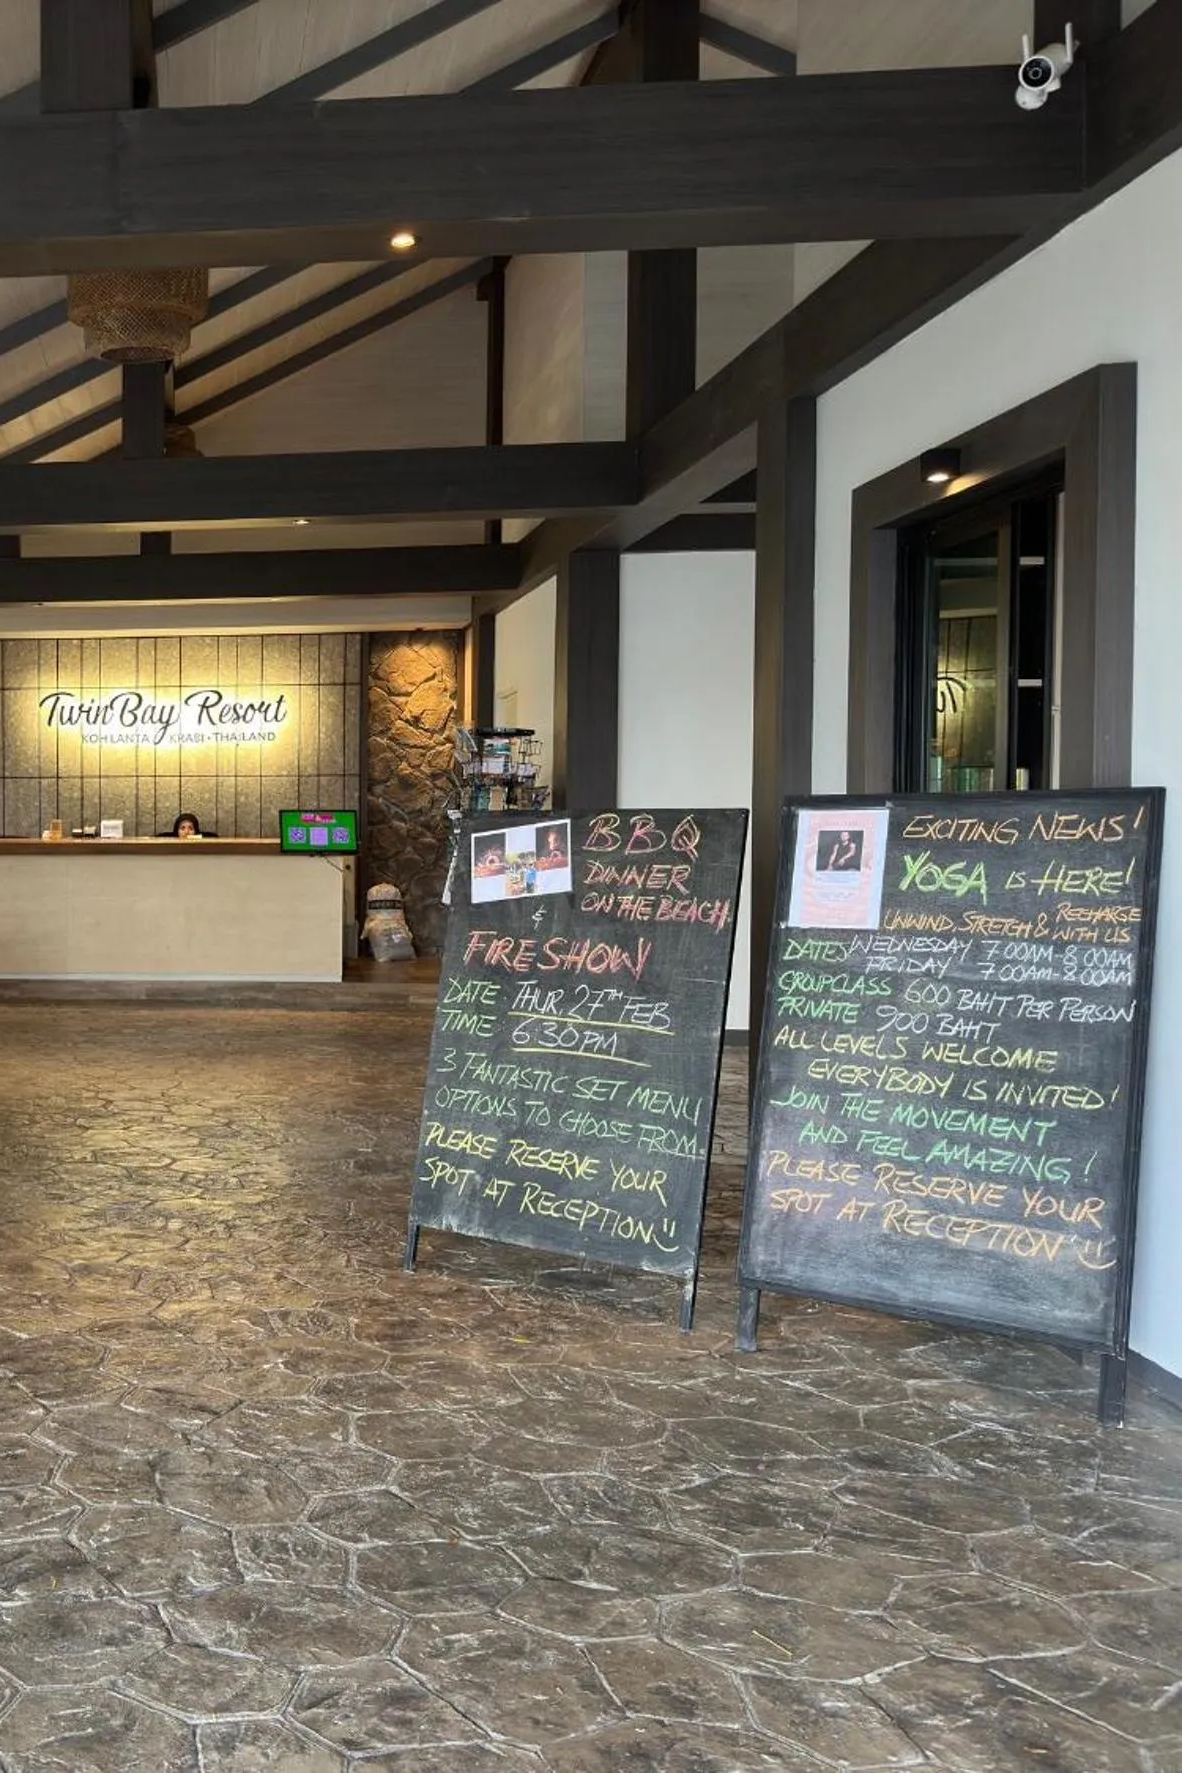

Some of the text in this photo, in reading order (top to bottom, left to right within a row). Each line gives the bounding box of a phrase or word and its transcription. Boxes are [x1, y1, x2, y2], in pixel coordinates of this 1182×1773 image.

[39, 690, 287, 745] Twin Bay Resort
[81, 731, 276, 744] KOH LANTA KRABI THAILAND
[582, 813, 701, 861] BBQ
[902, 814, 1019, 845] EXCITING
[583, 860, 691, 894] DINNER
[898, 849, 987, 905] YOGA
[581, 891, 615, 914] ON
[617, 896, 655, 921] THE
[1034, 912, 1049, 938] &
[849, 934, 973, 963] WEDNESDAY
[1052, 926, 1131, 944] WITH US
[866, 955, 953, 979] FRIDAY
[619, 996, 671, 1030] FEB
[777, 996, 1002, 1044] PRIVATE 900 BAHT
[905, 978, 952, 1006] 600
[956, 989, 1014, 1018] BAHT
[1017, 994, 1054, 1019] PER
[1058, 997, 1137, 1024] PERSON
[774, 1025, 1059, 1073] ALL LEVELS WELCOME
[436, 1048, 703, 1126] 3 FANTASTIC SET MENU
[808, 1058, 954, 1098] EVERYBODY
[963, 1079, 988, 1101] IS
[435, 1087, 517, 1117] OPTIONS
[525, 1101, 551, 1127] TO
[559, 1109, 632, 1144] CHOOSE
[770, 1085, 1056, 1147] JOIN THE MOVEMENT
[425, 1121, 667, 1208] PLEASE RESERVE YOUR
[798, 1122, 848, 1146] AND
[855, 1130, 921, 1162] FEEL
[419, 1157, 654, 1243] SPOT AT RECEPTION
[766, 1150, 1104, 1229] PLEASE RESERVE YOUR
[770, 1189, 1065, 1262] SPOT AT RECEPTION
